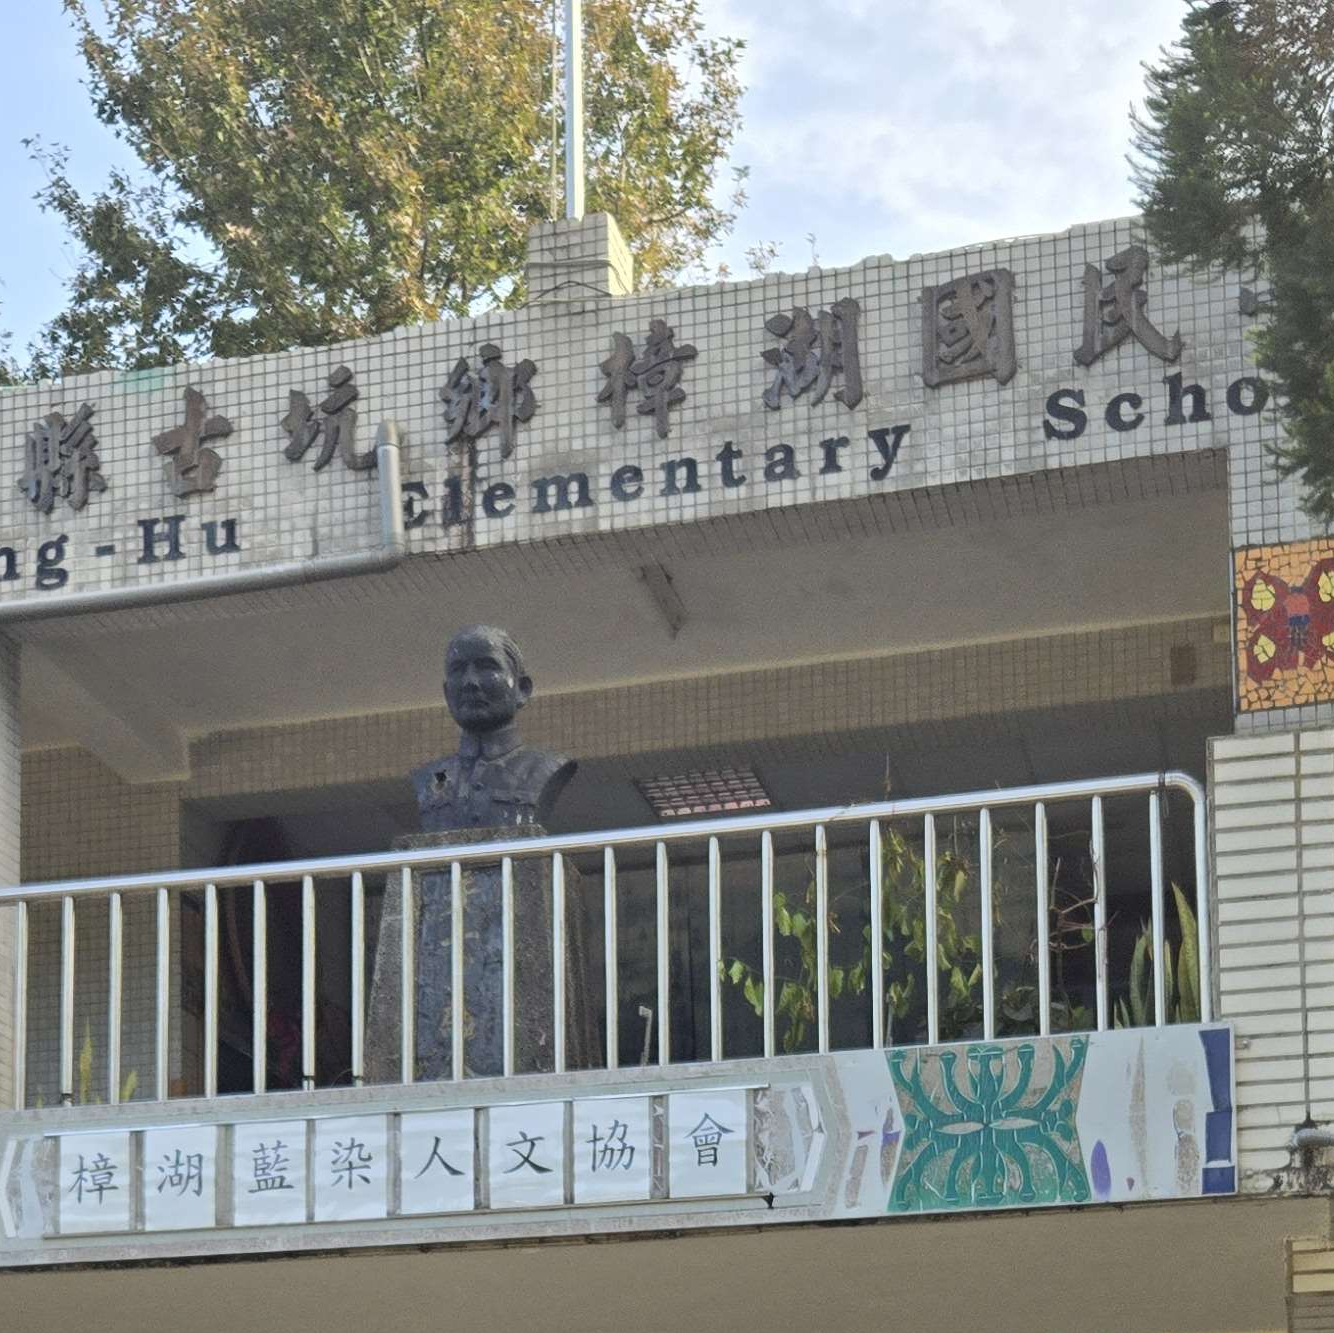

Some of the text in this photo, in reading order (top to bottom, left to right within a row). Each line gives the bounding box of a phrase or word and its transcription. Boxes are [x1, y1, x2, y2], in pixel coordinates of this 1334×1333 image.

[1043, 371, 1271, 441] Scho
[68, 1111, 736, 1206] 樟湖藍染人文協會
